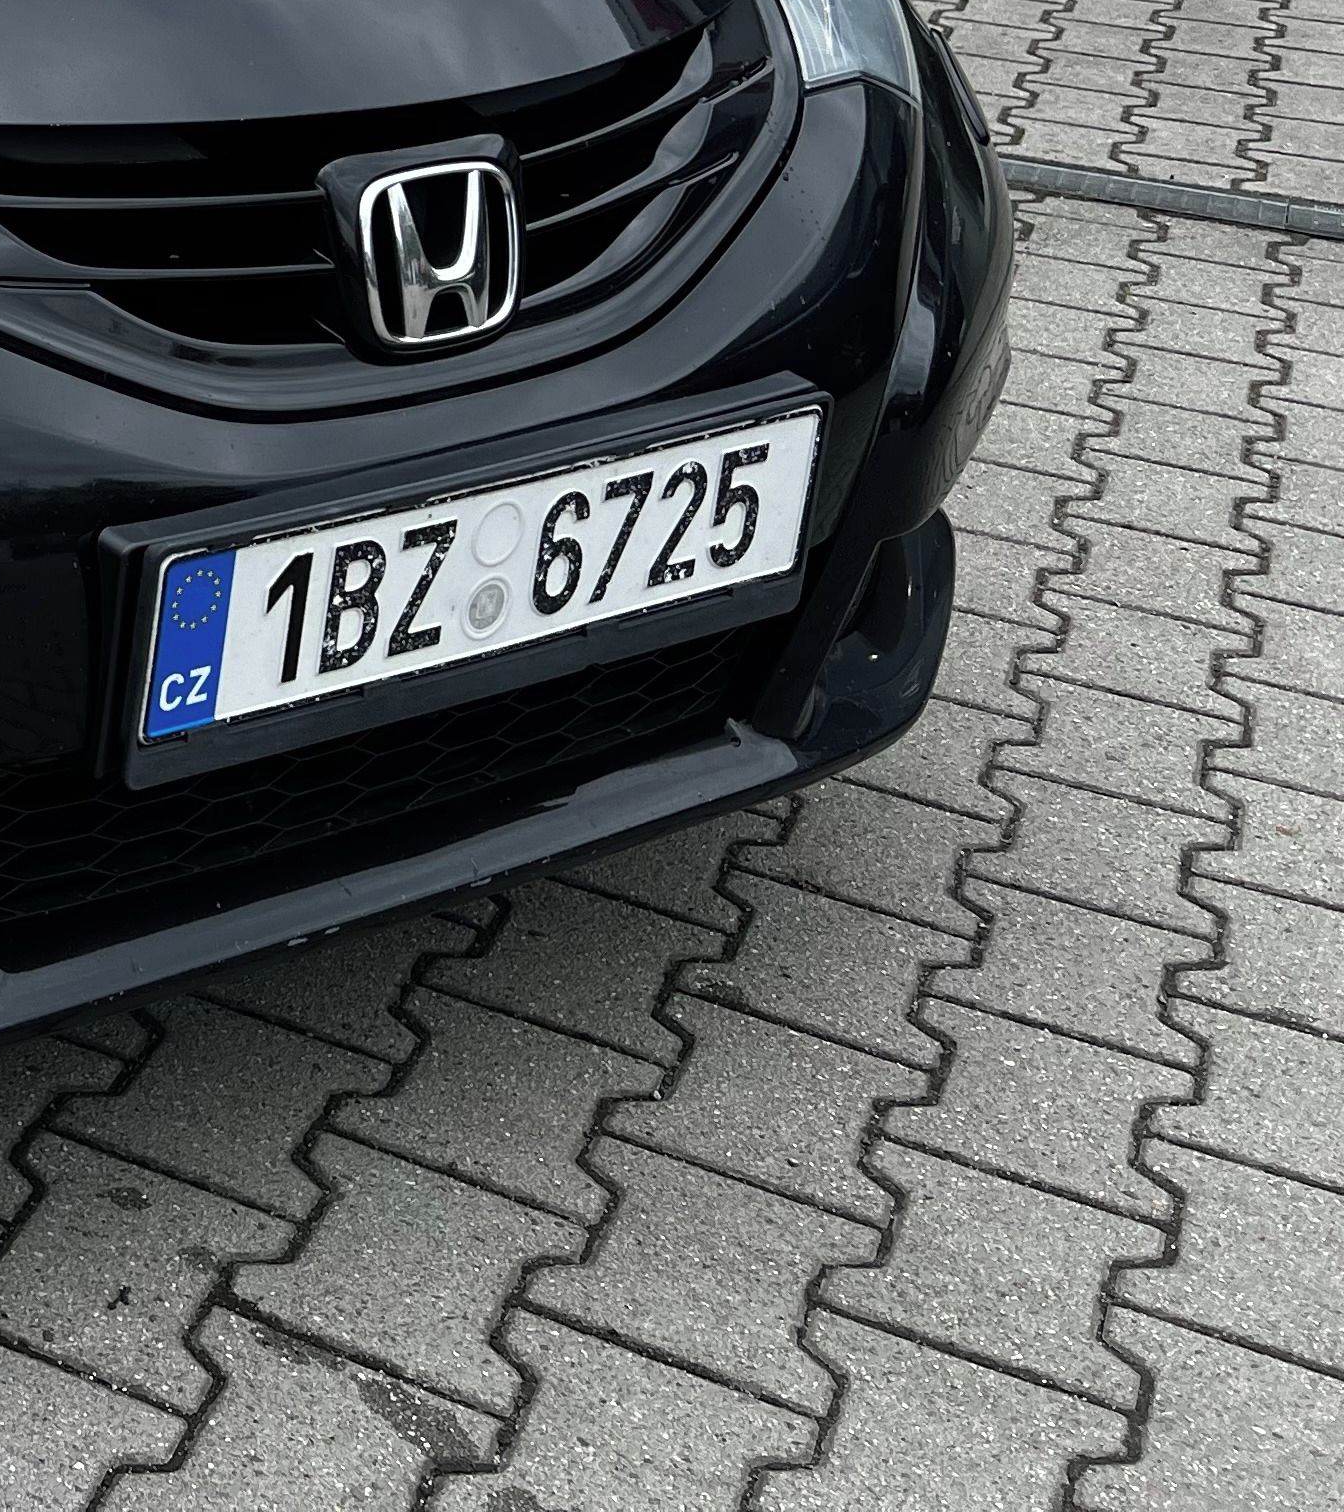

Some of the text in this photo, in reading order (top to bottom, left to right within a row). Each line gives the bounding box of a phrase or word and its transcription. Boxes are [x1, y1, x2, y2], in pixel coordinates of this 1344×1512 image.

[265, 441, 771, 685] 1BZ 6725
[158, 666, 210, 714] CZ
